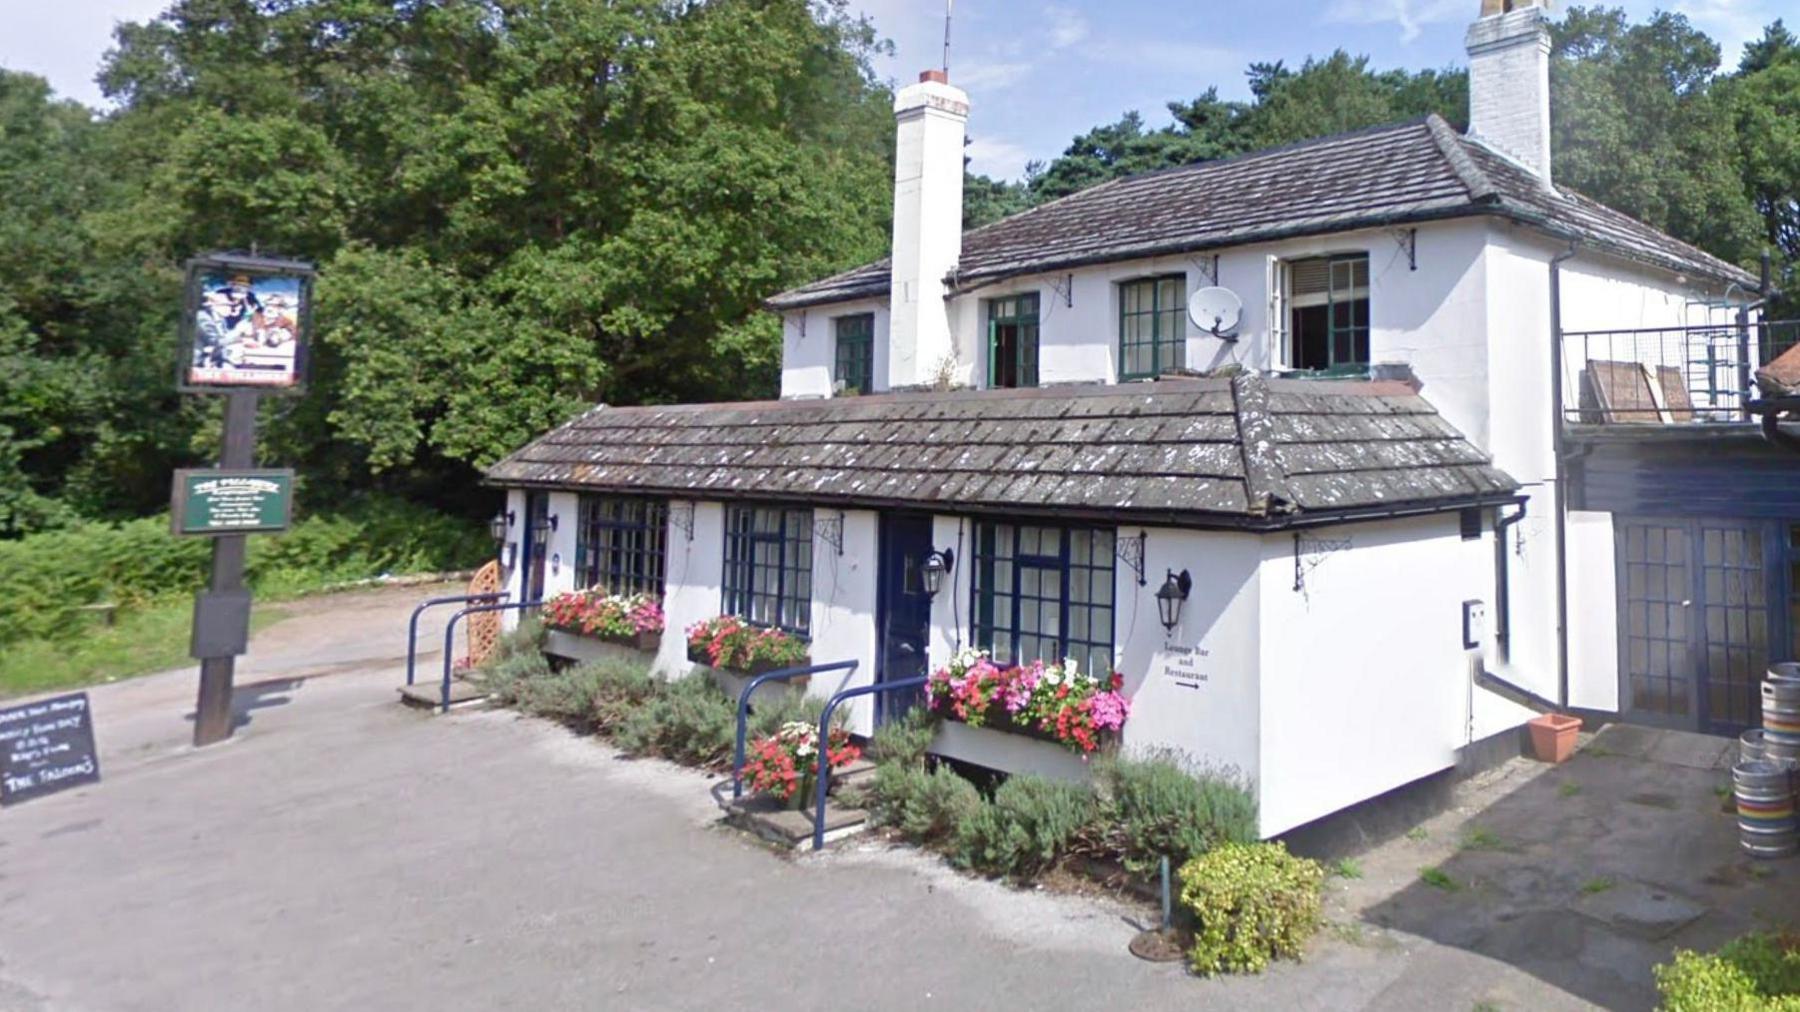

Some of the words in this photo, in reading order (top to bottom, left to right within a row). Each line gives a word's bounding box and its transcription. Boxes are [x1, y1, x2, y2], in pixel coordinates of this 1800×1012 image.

[1164, 641, 1192, 655] Lounge
[1195, 647, 1209, 657] Bar
[1179, 657, 1194, 667] and
[1164, 666, 1208, 681] Restaurant
